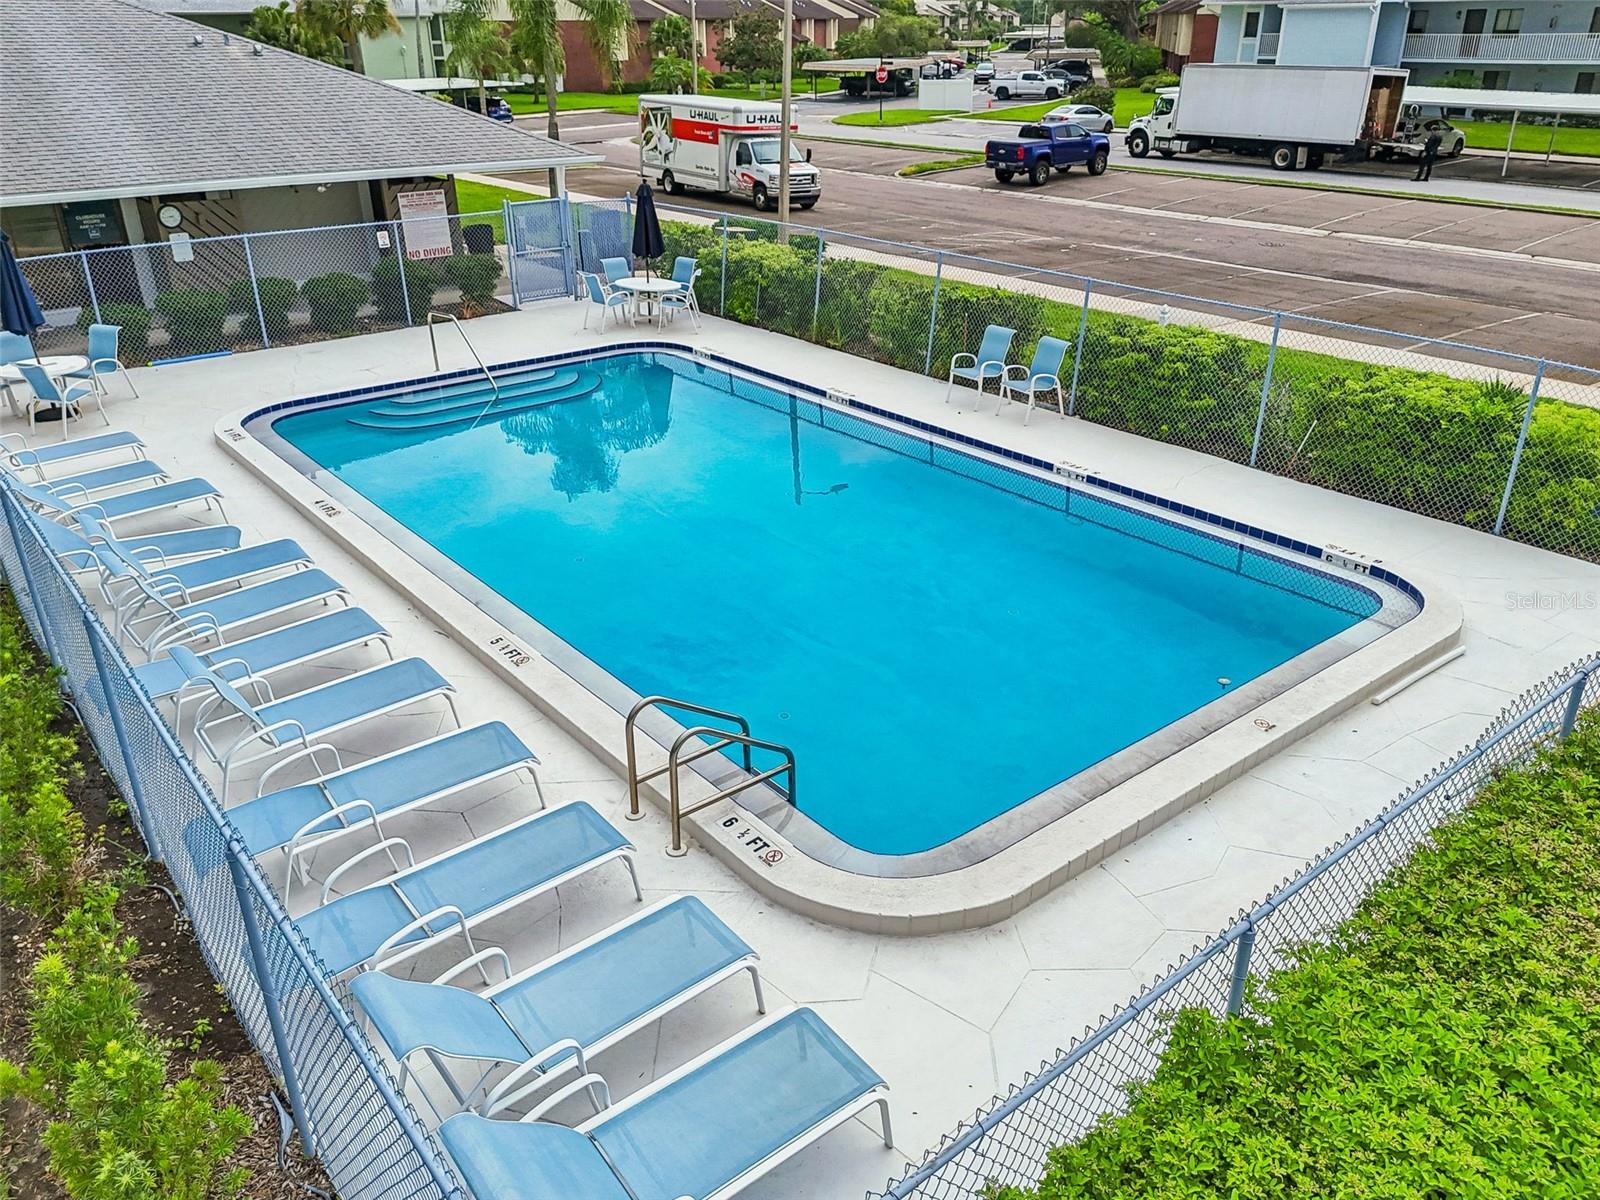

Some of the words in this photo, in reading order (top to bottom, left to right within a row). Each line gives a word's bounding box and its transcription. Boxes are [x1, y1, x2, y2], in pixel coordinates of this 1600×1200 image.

[690, 109, 719, 121] U-HAUL
[409, 249, 421, 259] NO
[423, 246, 452, 256] DIVING
[1354, 564, 1368, 572] FT
[490, 637, 503, 645] 5
[504, 649, 522, 659] FT
[722, 817, 738, 827] 6
[745, 836, 770, 852] FT
